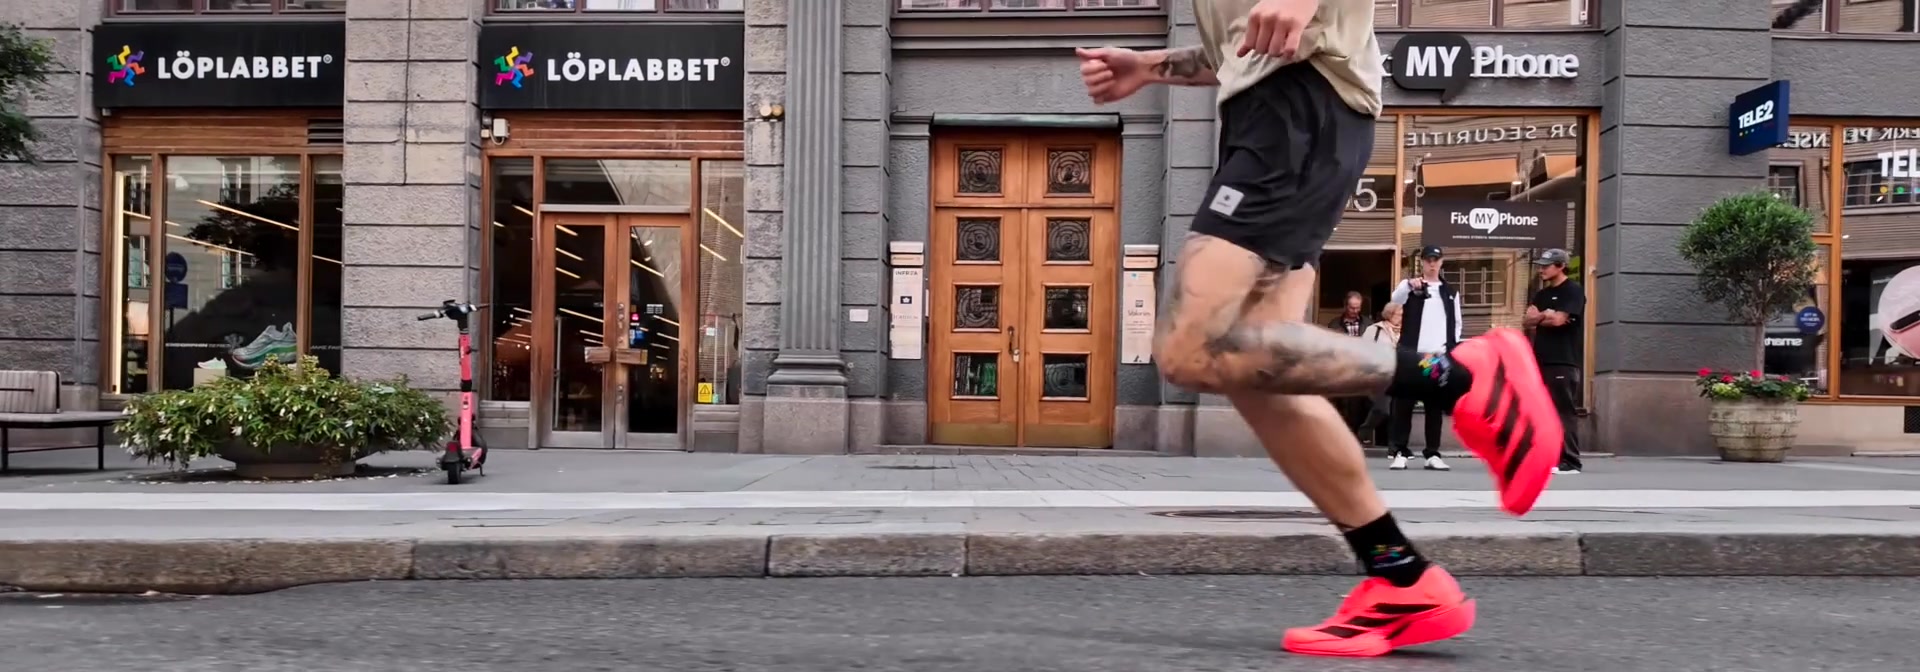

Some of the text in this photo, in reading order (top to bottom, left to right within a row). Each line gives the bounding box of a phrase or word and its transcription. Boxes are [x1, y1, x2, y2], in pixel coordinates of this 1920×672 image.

[1405, 45, 1462, 77] MY
[1472, 44, 1580, 78] Phone
[1738, 100, 1774, 129] TELE2
[1450, 212, 1539, 226] Fix MY Phone
